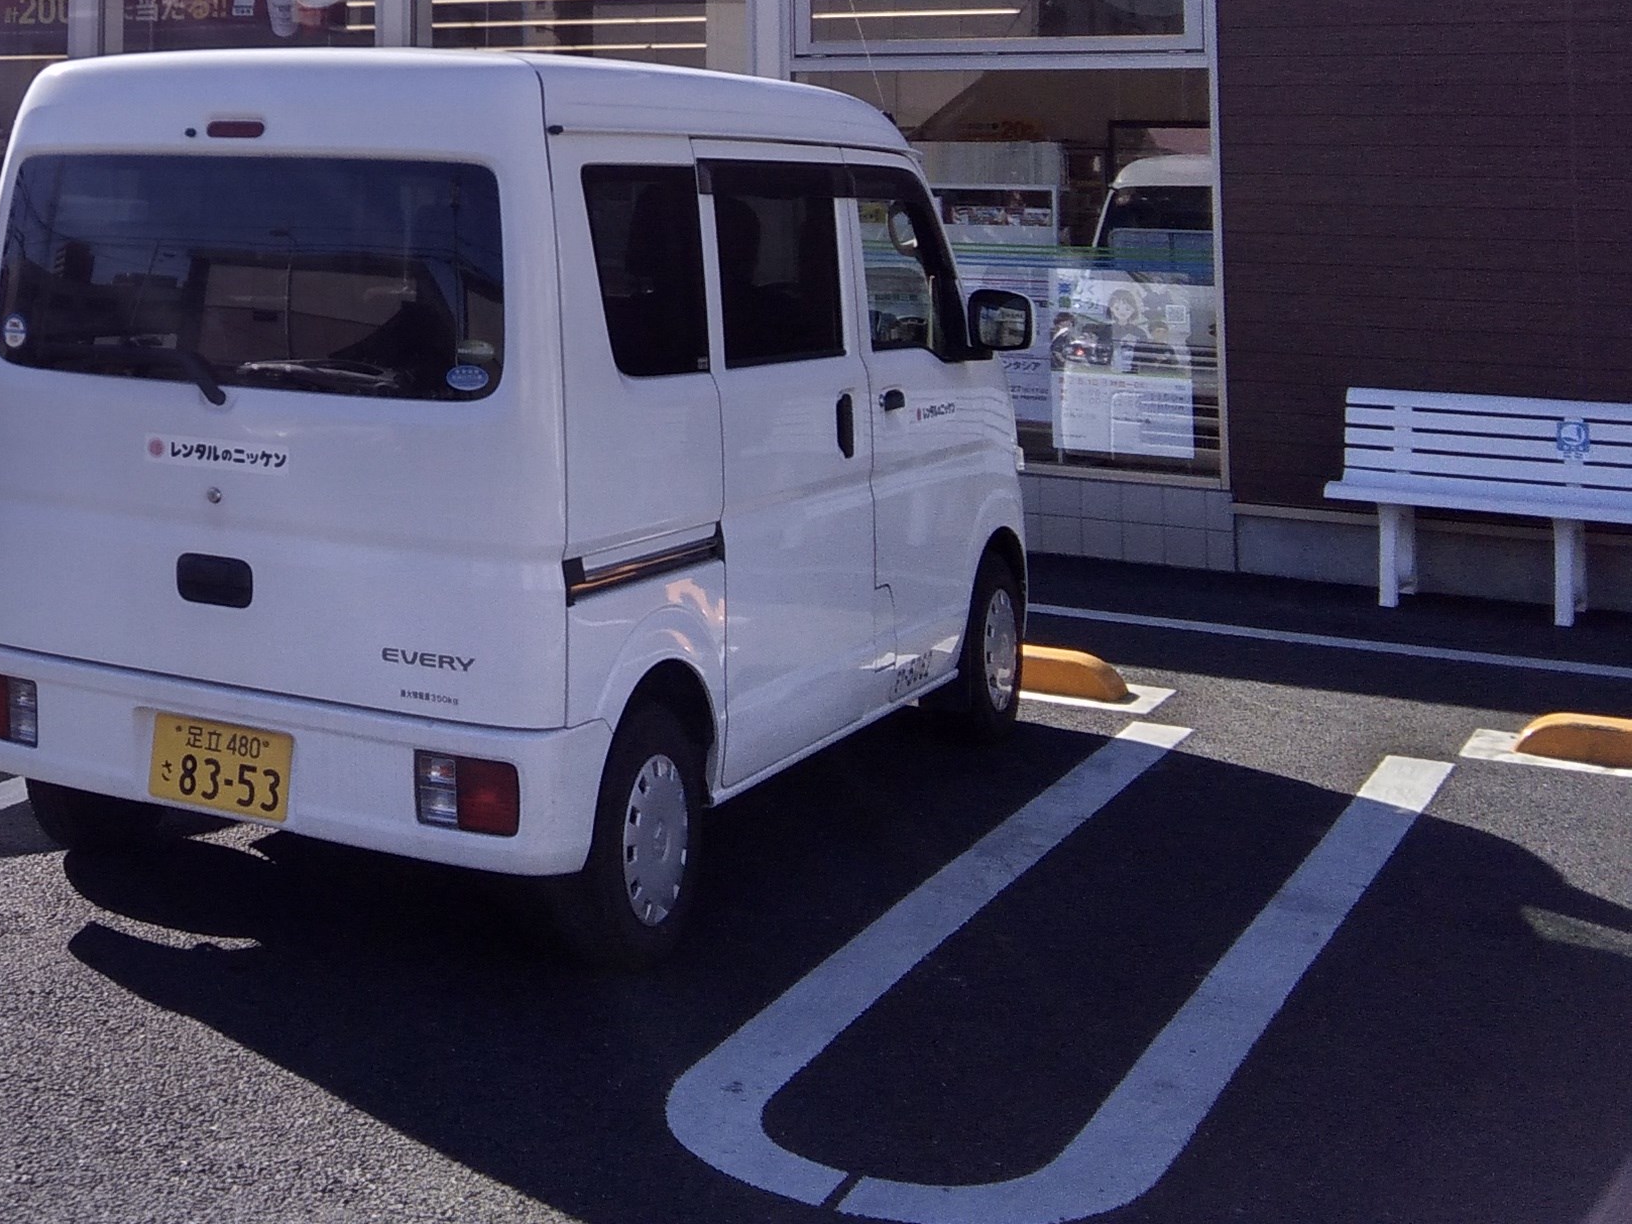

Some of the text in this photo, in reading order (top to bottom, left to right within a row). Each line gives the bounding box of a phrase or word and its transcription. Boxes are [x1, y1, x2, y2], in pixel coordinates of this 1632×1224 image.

[170, 440, 288, 468] レンタルのニッケン
[381, 646, 476, 673] EVERY
[185, 725, 262, 759] 足立 480
[160, 753, 281, 813] さ 83-53
